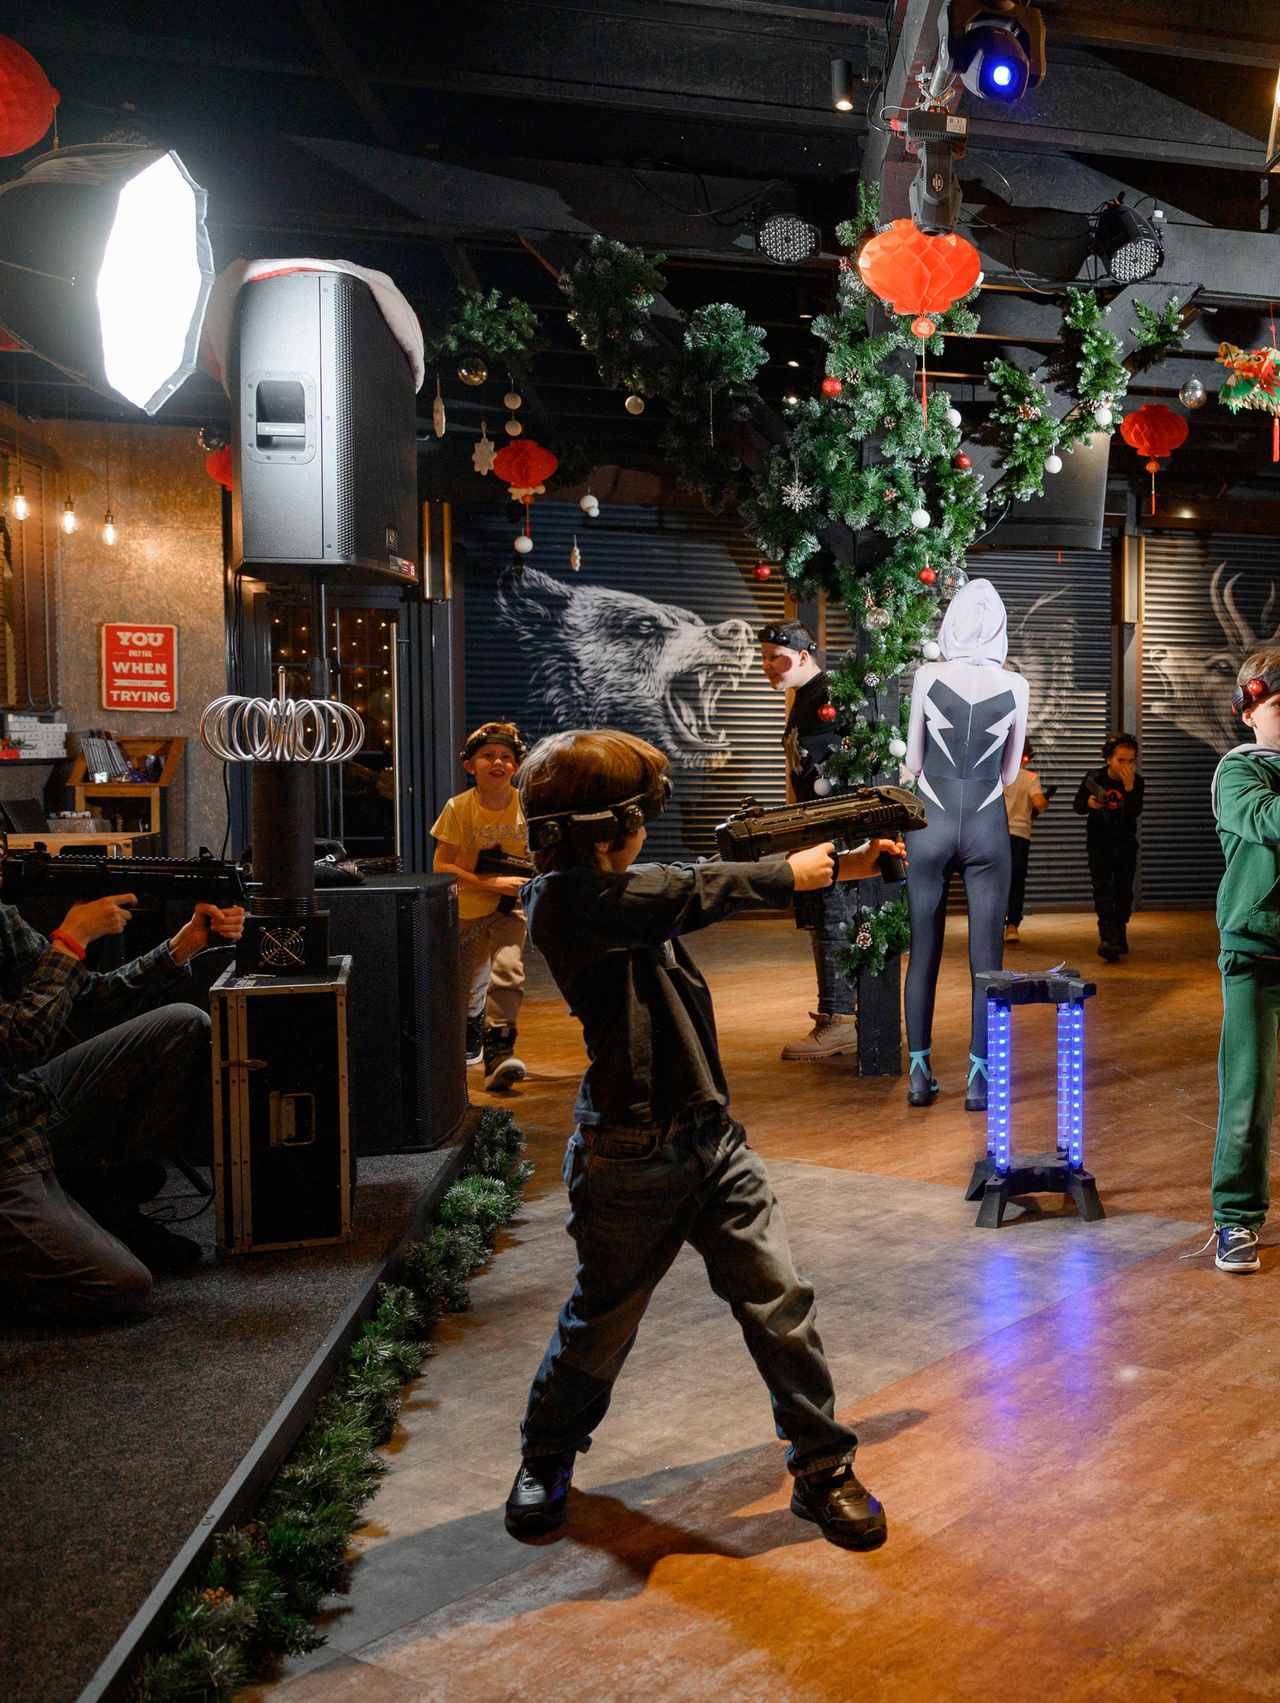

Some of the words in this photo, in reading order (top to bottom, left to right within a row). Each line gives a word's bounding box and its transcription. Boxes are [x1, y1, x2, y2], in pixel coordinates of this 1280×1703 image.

[116, 631, 165, 647] YOU
[142, 650, 153, 658] FAIL
[111, 661, 168, 675] WHEN
[110, 690, 171, 703] TRYING
